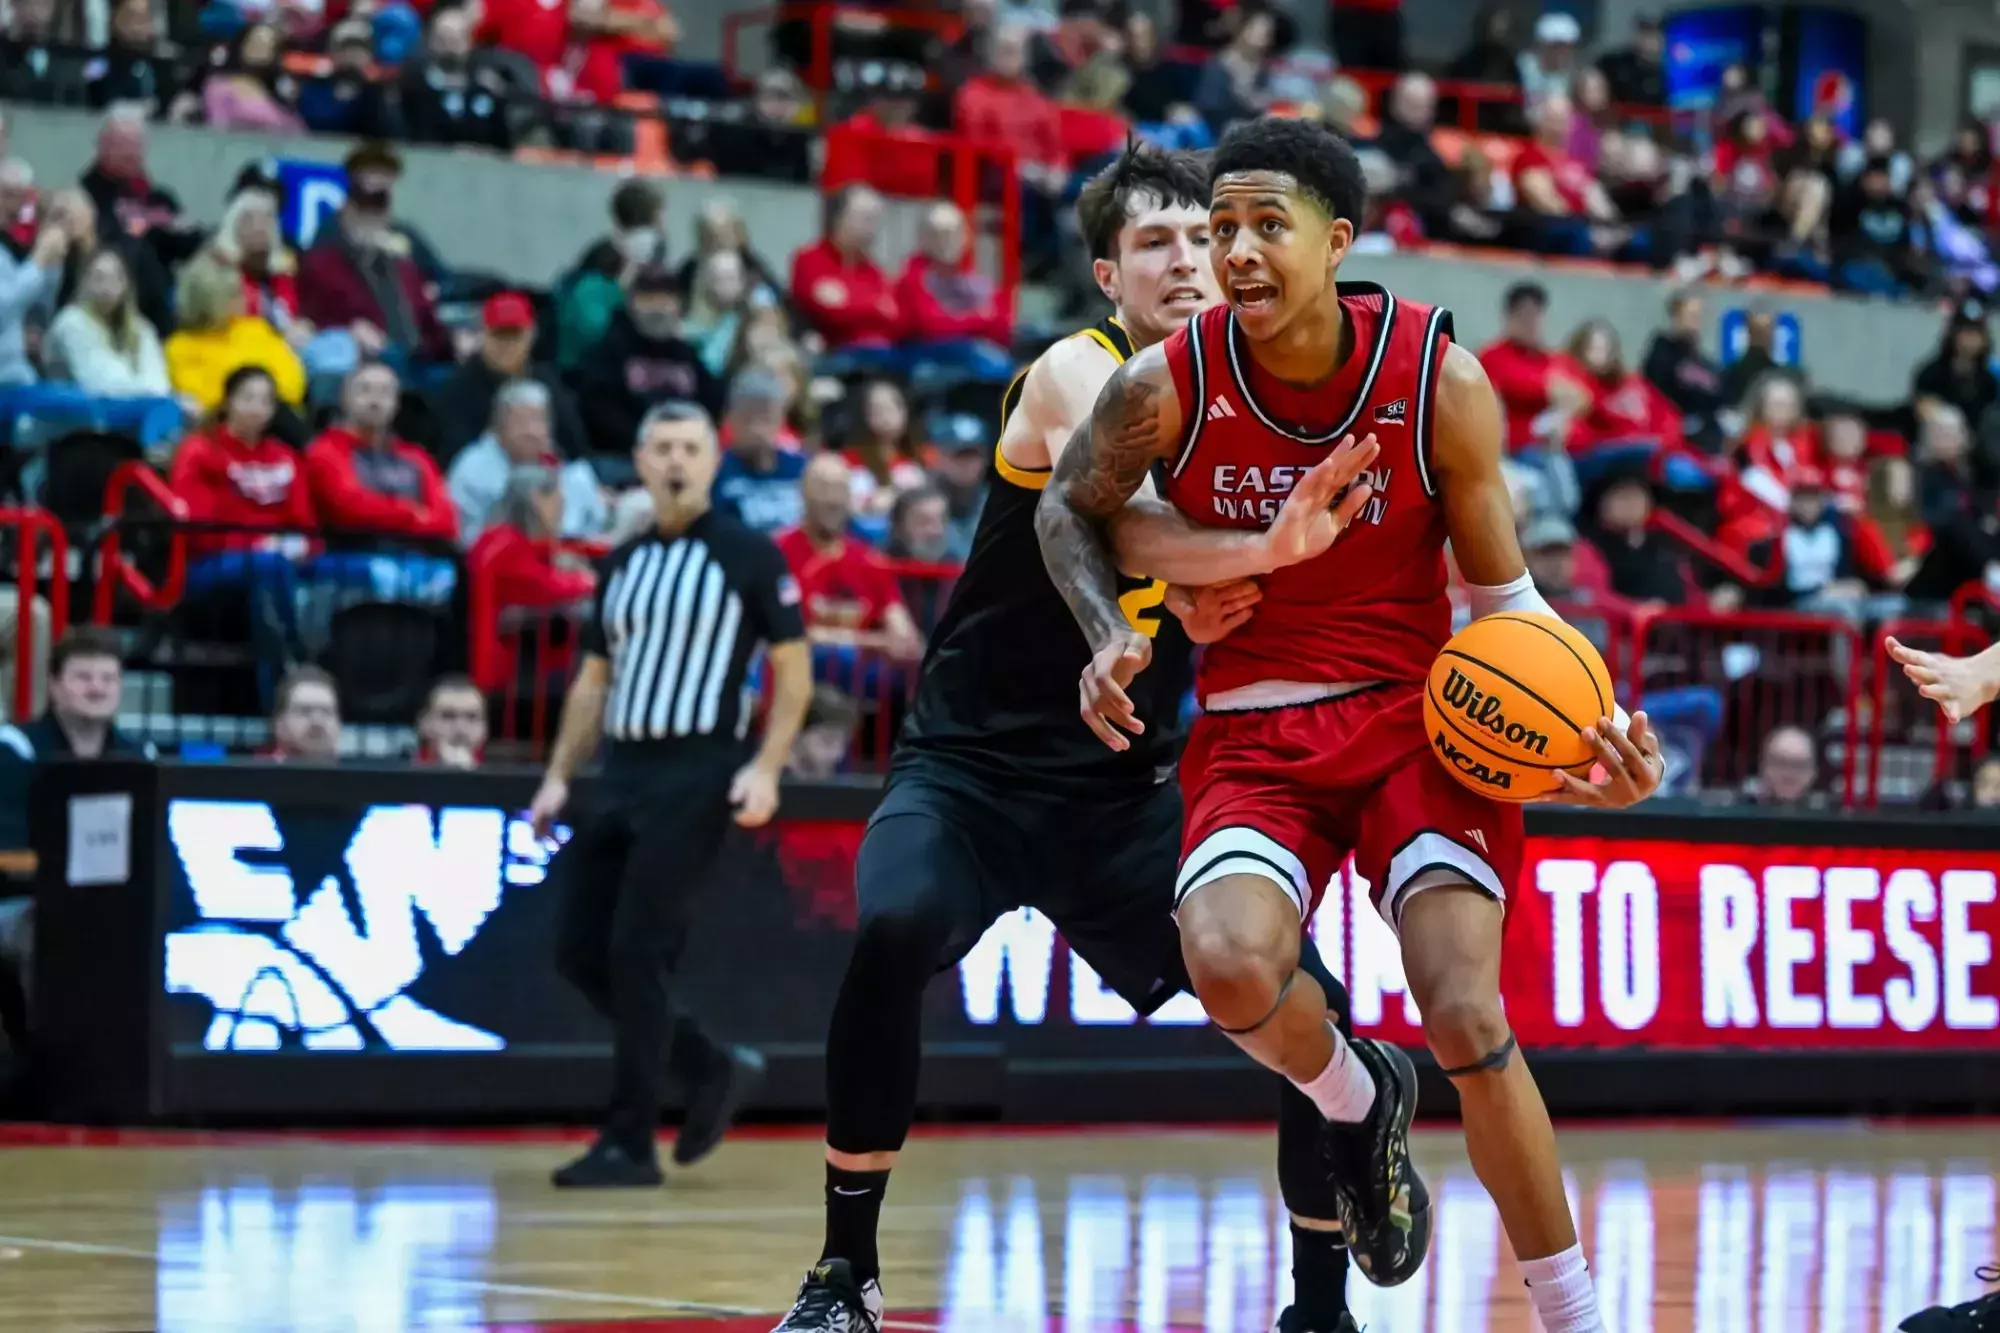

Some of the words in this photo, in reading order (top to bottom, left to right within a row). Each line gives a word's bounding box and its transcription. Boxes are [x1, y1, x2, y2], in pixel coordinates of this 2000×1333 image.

[1387, 400, 1406, 416] SKY
[1213, 464, 1392, 494] EASRN
[1442, 667, 1549, 756] Wilson
[1434, 730, 1512, 790] NCAA
[1536, 857, 1660, 1031] TO
[1699, 863, 2000, 1032] REESE
